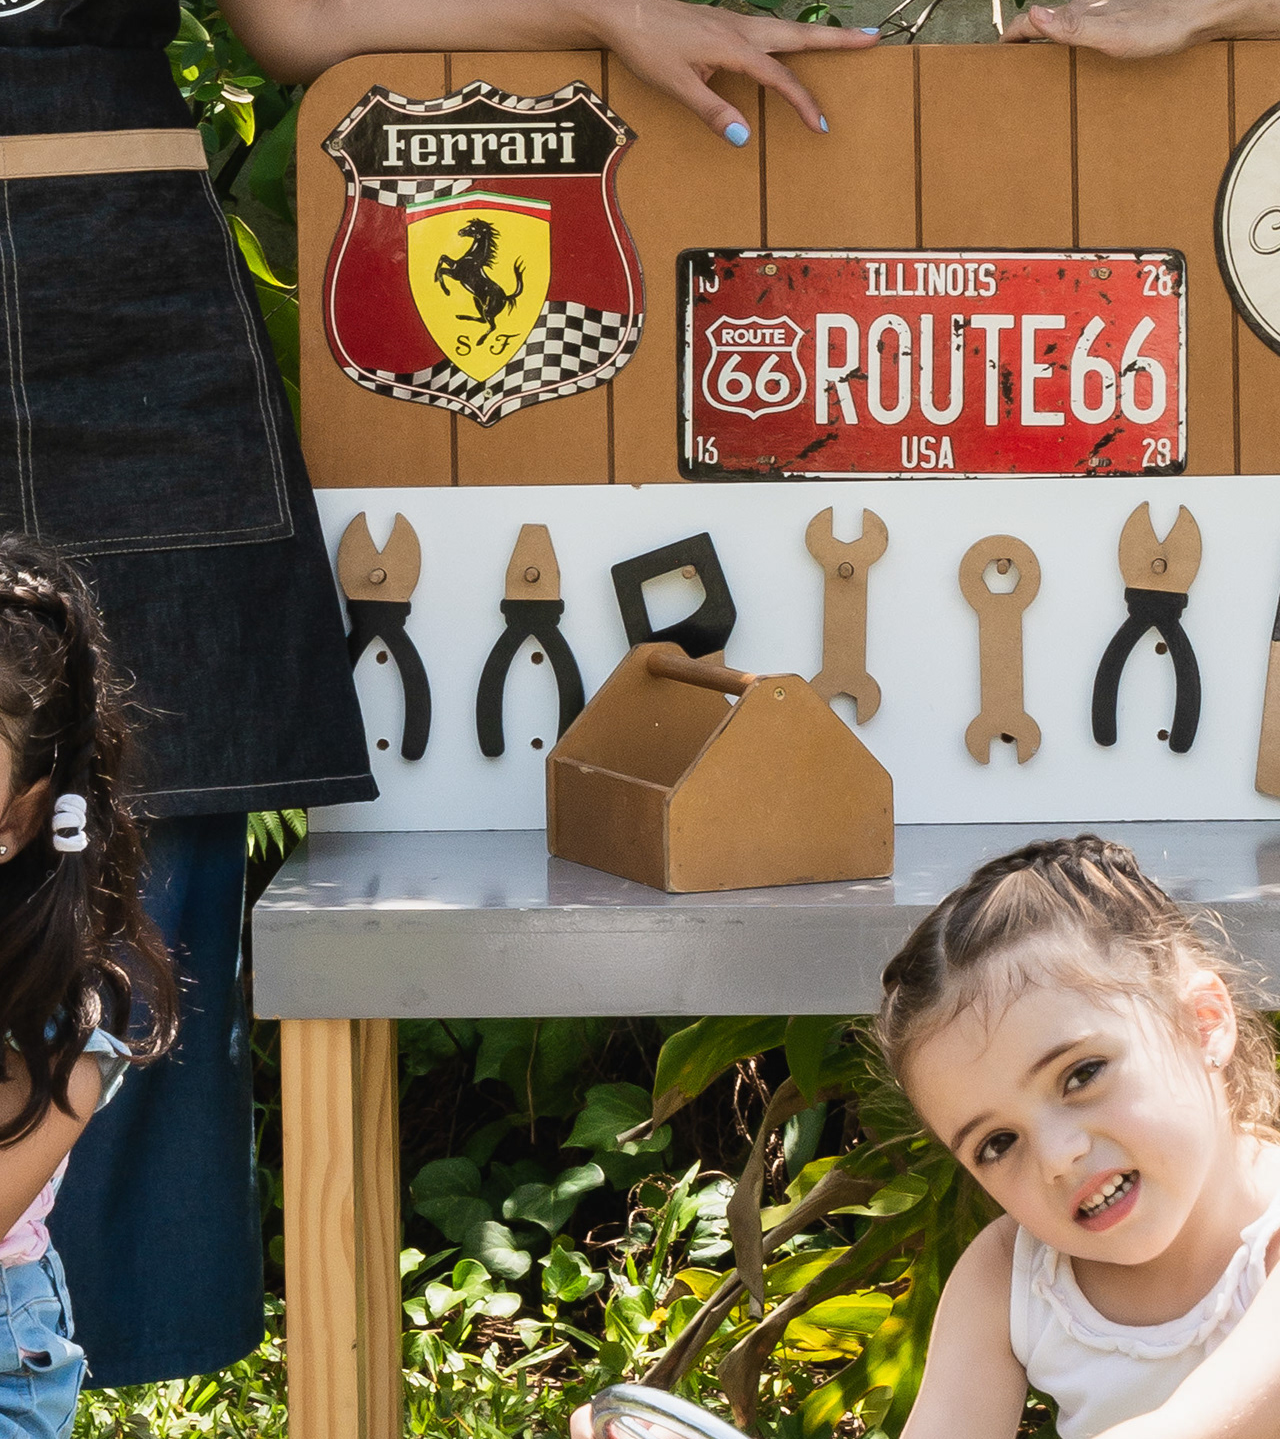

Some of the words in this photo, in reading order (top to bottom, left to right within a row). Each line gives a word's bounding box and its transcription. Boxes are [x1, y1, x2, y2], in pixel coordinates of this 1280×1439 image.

[382, 122, 576, 167] Ferrari
[865, 262, 998, 297] ILLINOIS
[721, 328, 786, 345] ROUTE
[717, 352, 791, 404] 66
[696, 435, 719, 465] 16
[900, 435, 956, 470] USA
